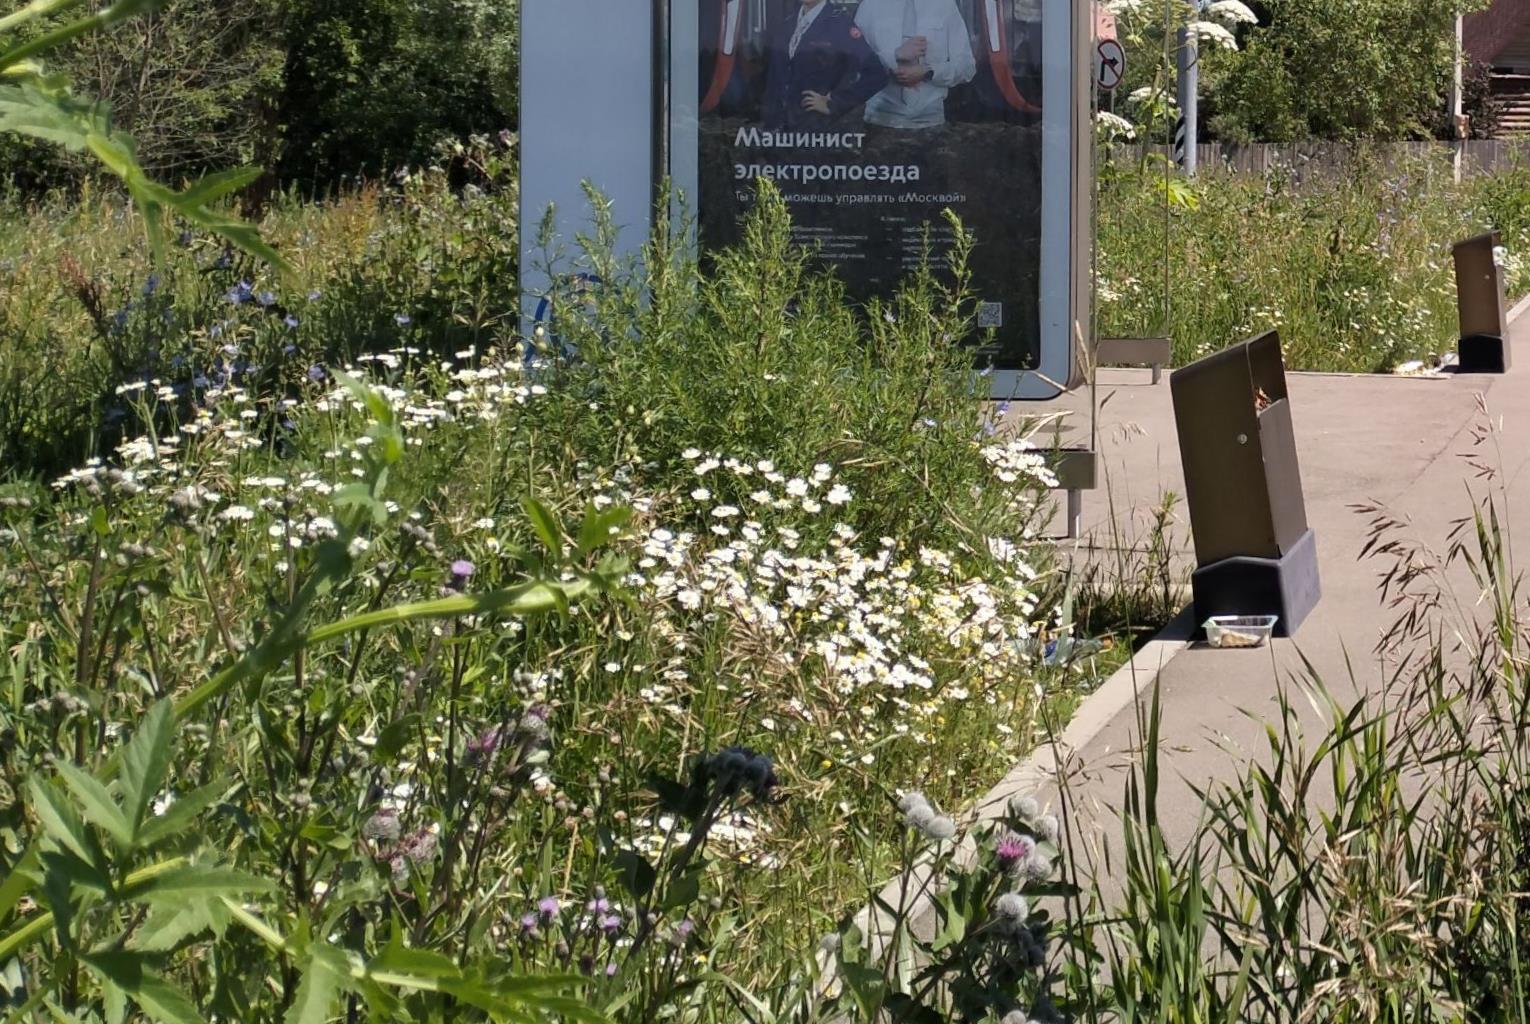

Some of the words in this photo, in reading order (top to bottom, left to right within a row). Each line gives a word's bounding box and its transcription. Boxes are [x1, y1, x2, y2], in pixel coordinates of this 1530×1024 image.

[734, 126, 866, 148] Машинист
[734, 163, 920, 184] электропоезда
[736, 190, 748, 201] Ты
[784, 193, 833, 203] можешь
[835, 193, 895, 205] управлять
